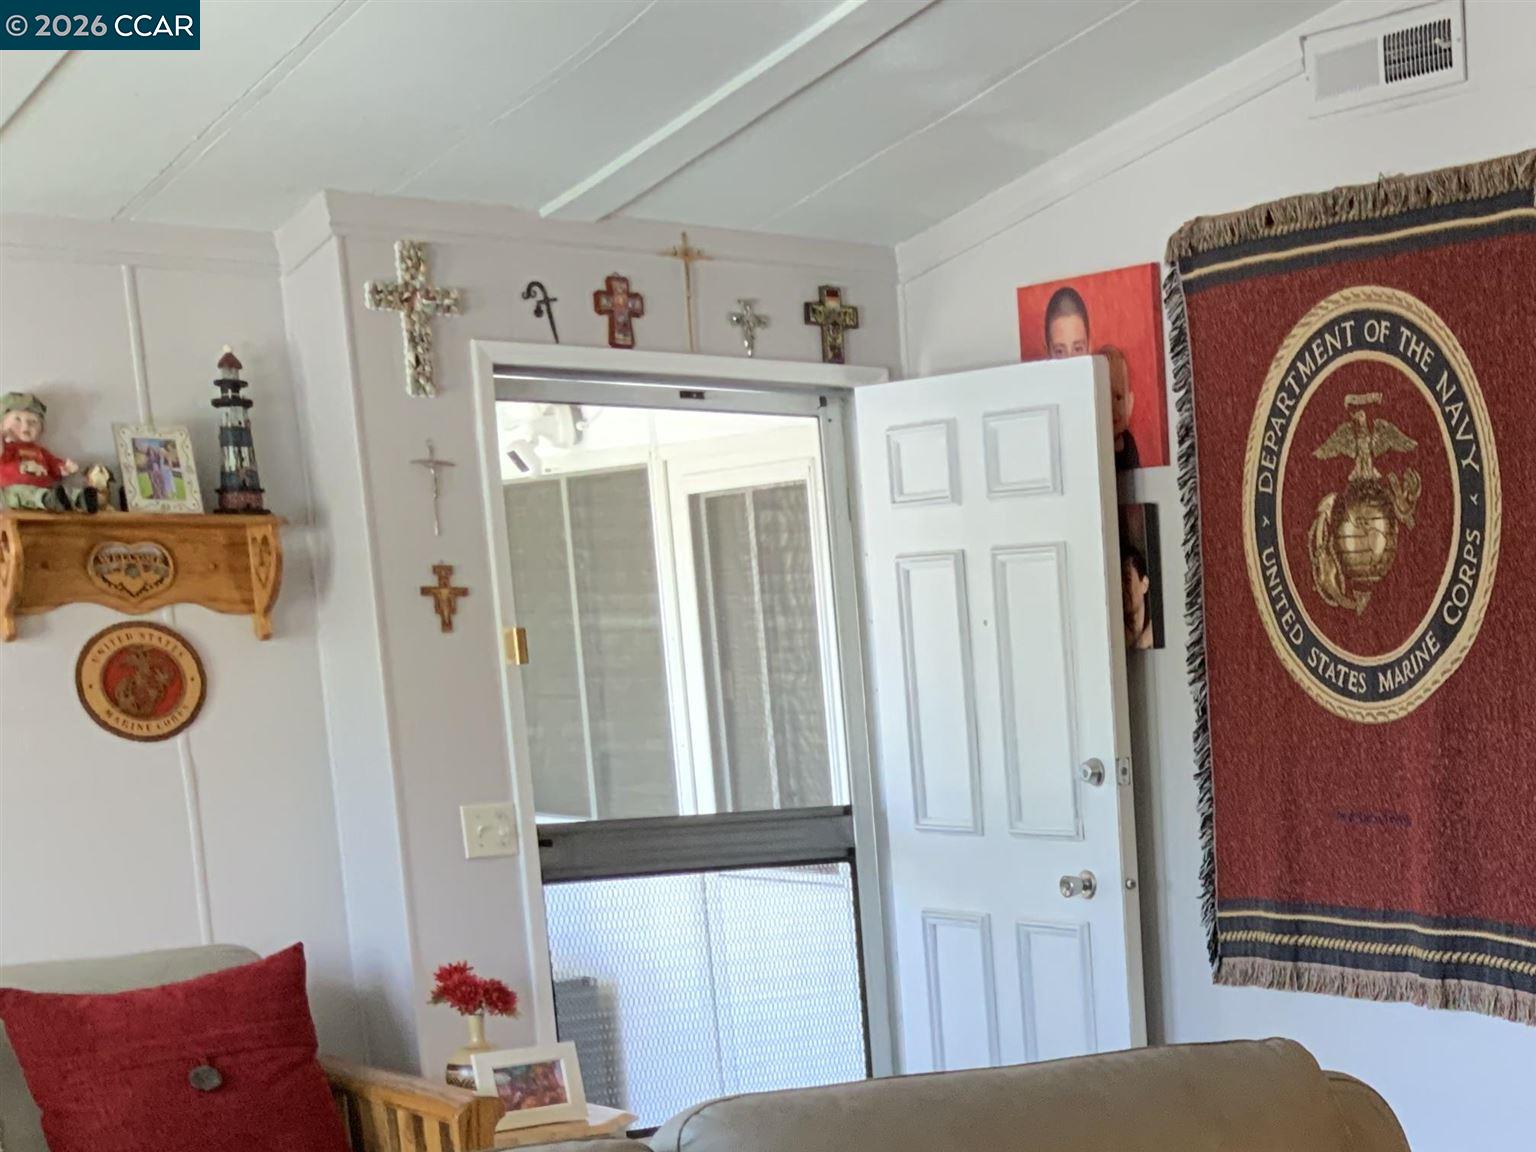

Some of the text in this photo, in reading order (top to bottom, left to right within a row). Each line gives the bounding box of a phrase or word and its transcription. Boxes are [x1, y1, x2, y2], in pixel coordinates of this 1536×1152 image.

[1258, 318, 1482, 496] DEPARTMENT OF THE NAVY
[91, 631, 184, 664] UNITED STATES
[1259, 526, 1483, 694] UNITED STATES MARINE CORPS
[104, 709, 152, 733] MARINE
